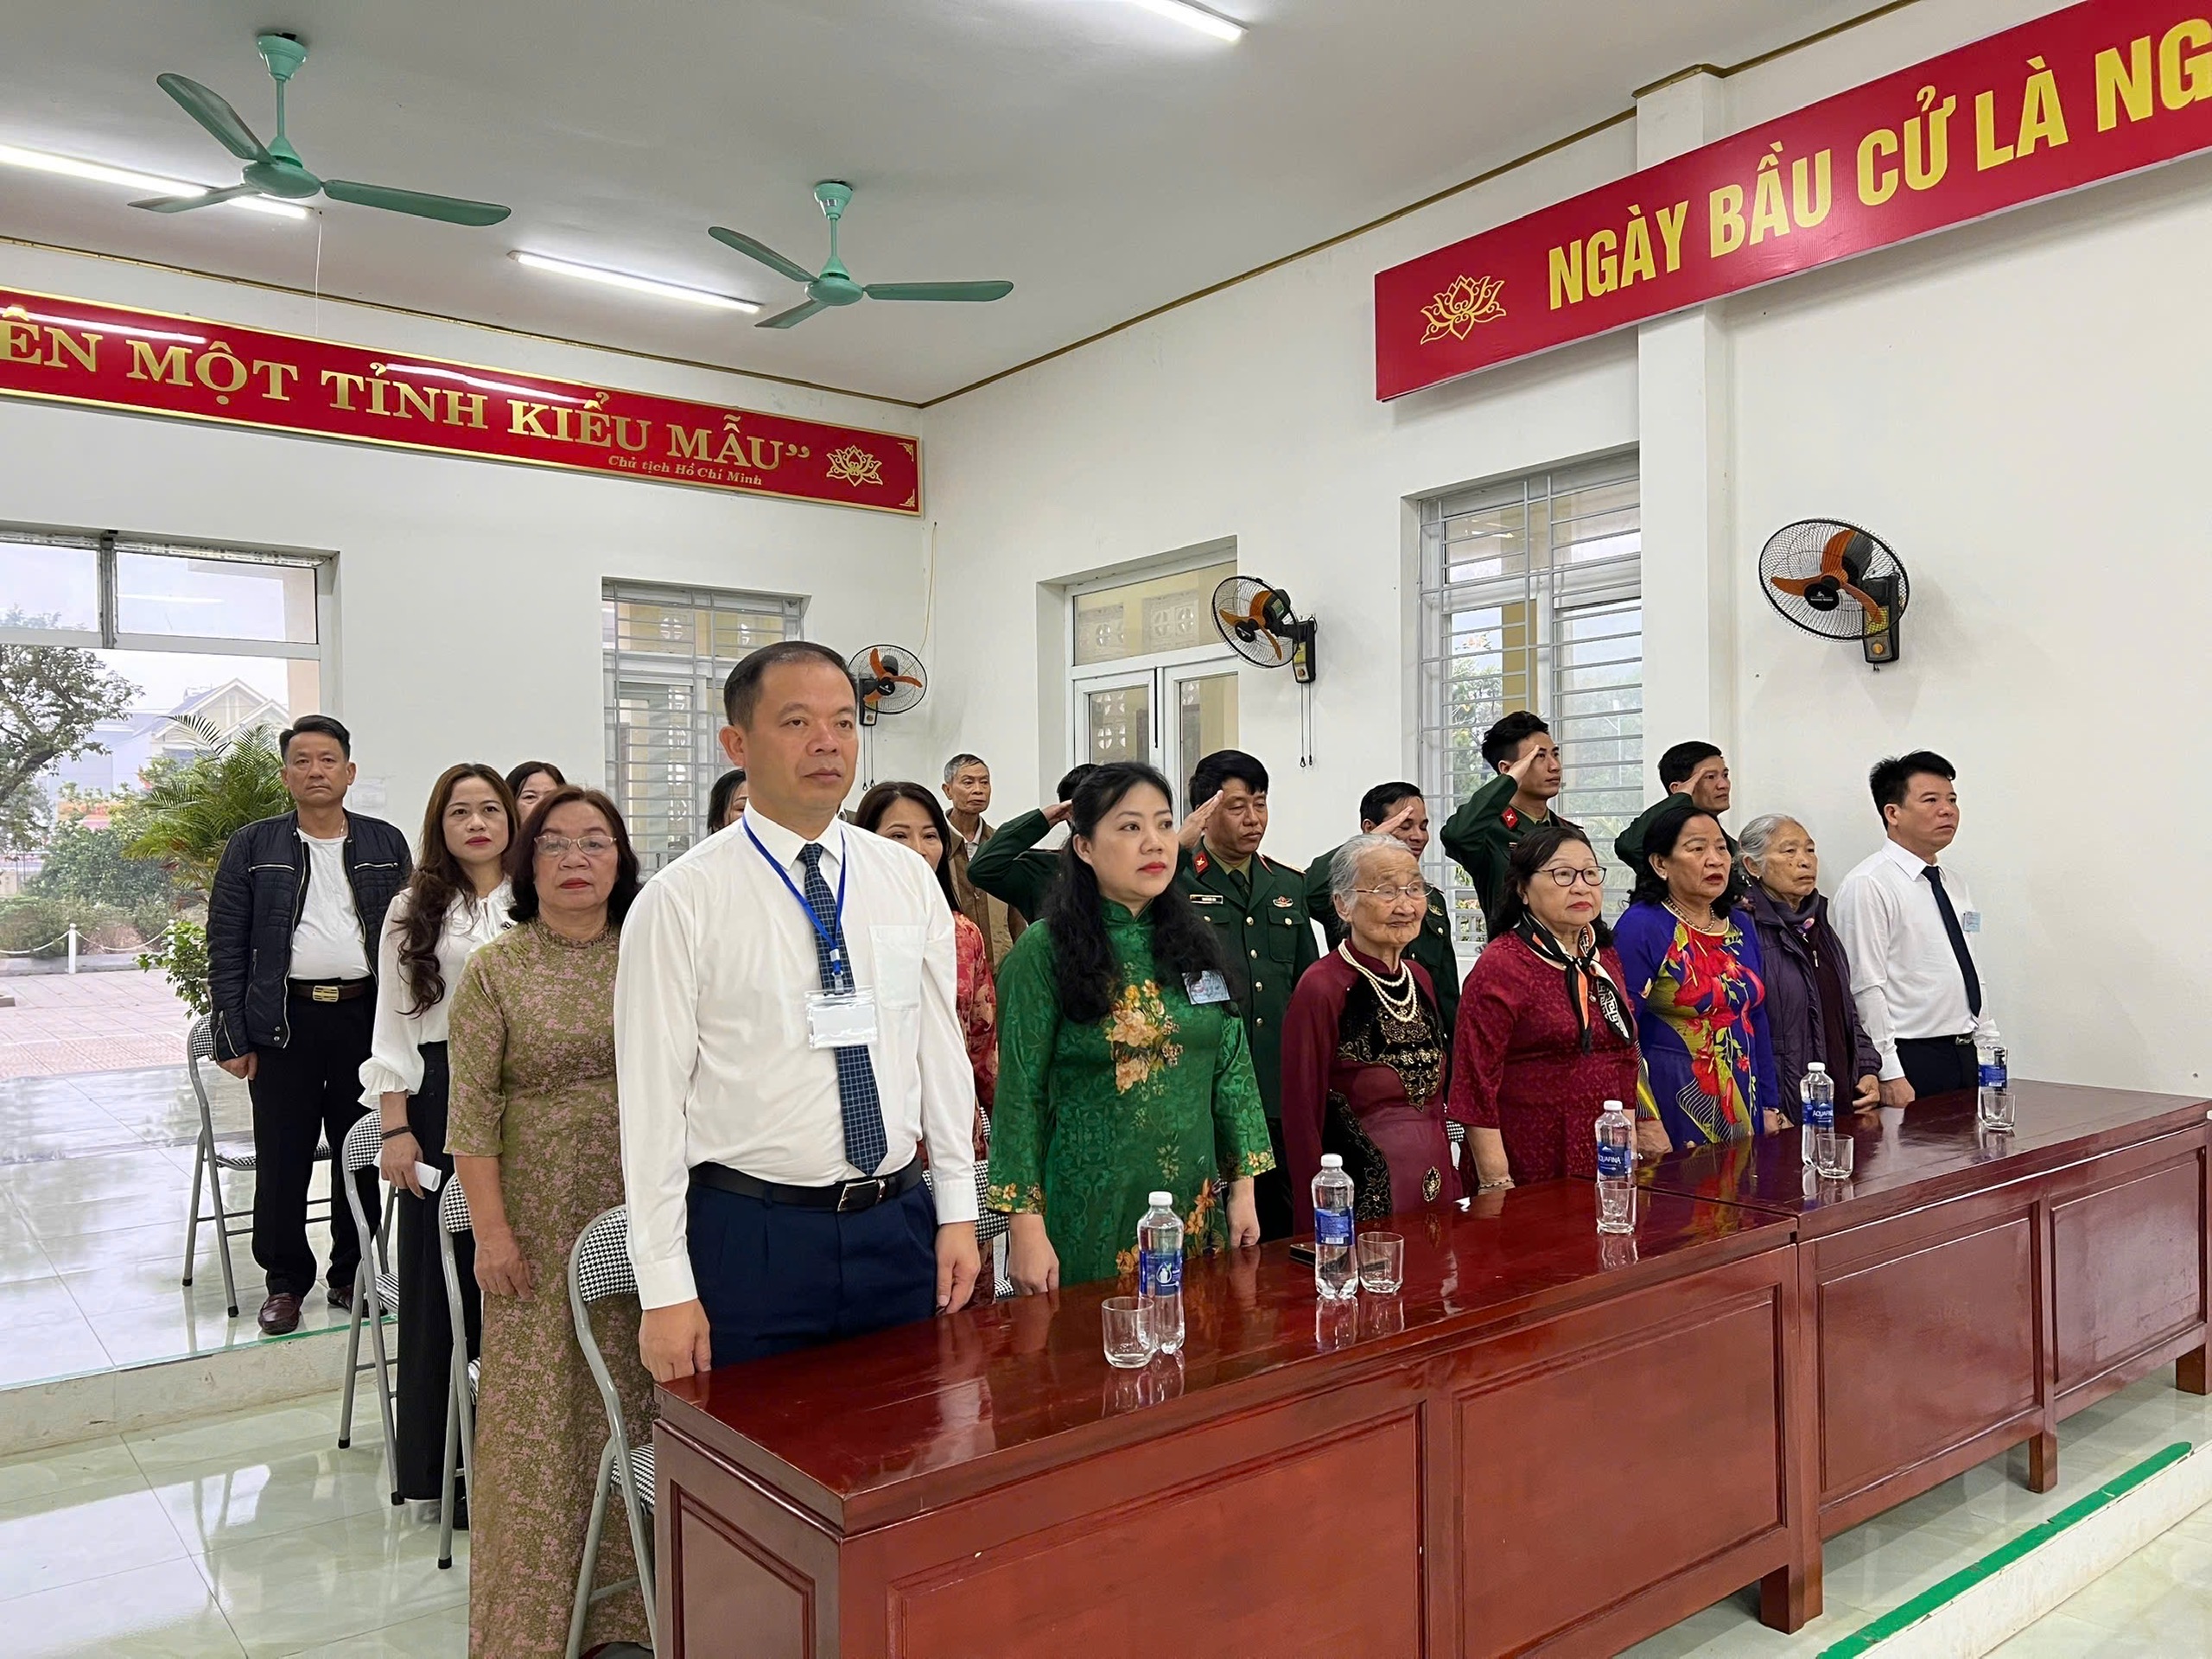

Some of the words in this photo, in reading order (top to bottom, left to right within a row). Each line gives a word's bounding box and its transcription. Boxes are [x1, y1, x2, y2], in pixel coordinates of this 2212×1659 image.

[1548, 201, 1689, 310] NGÀY
[1710, 142, 1832, 259] BẦU
[1857, 84, 1956, 207] CỬ
[1975, 55, 2069, 172] LÀ
[125, 339, 298, 405] MỘT
[321, 361, 488, 429] TỈNH
[507, 391, 652, 452] KIỂU
[607, 455, 637, 468] Chủ
[642, 461, 670, 474] tịch
[674, 462, 695, 476] Hồ
[697, 467, 722, 480] Chí
[727, 471, 762, 486] Minh
